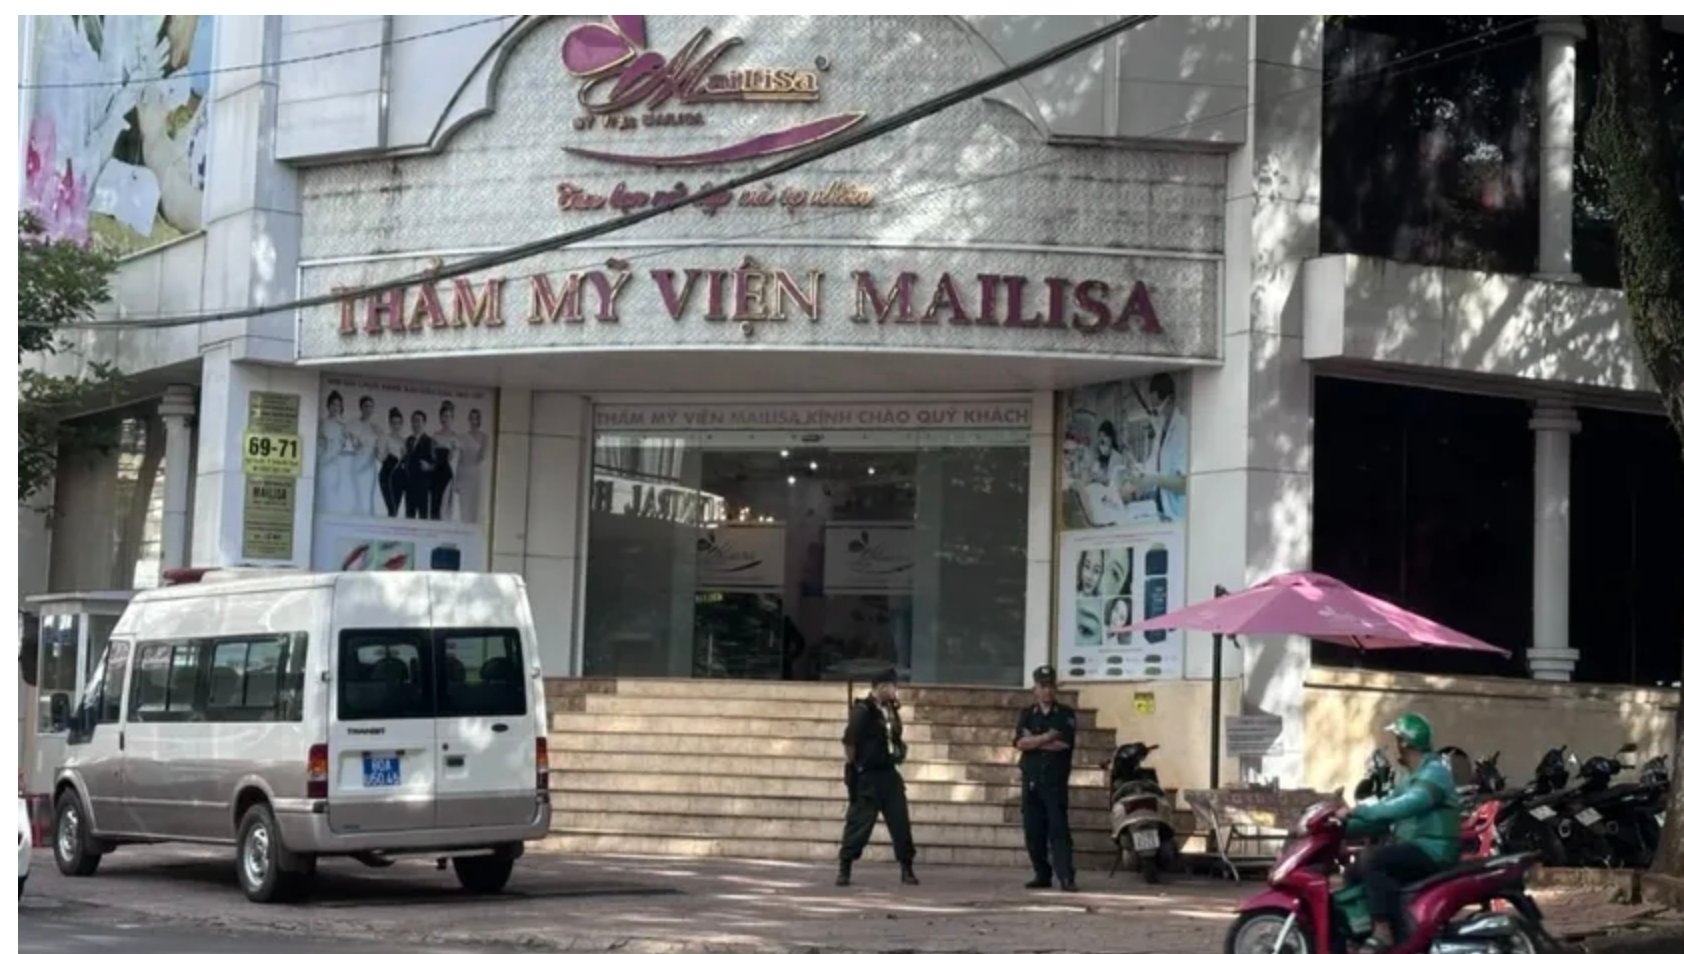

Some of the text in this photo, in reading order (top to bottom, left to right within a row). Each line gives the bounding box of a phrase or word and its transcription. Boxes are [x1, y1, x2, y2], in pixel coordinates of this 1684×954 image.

[529, 257, 633, 324] MỸ
[651, 254, 826, 338] VIỆN
[850, 269, 1164, 335] MAILISA
[249, 436, 298, 459] 69-71
